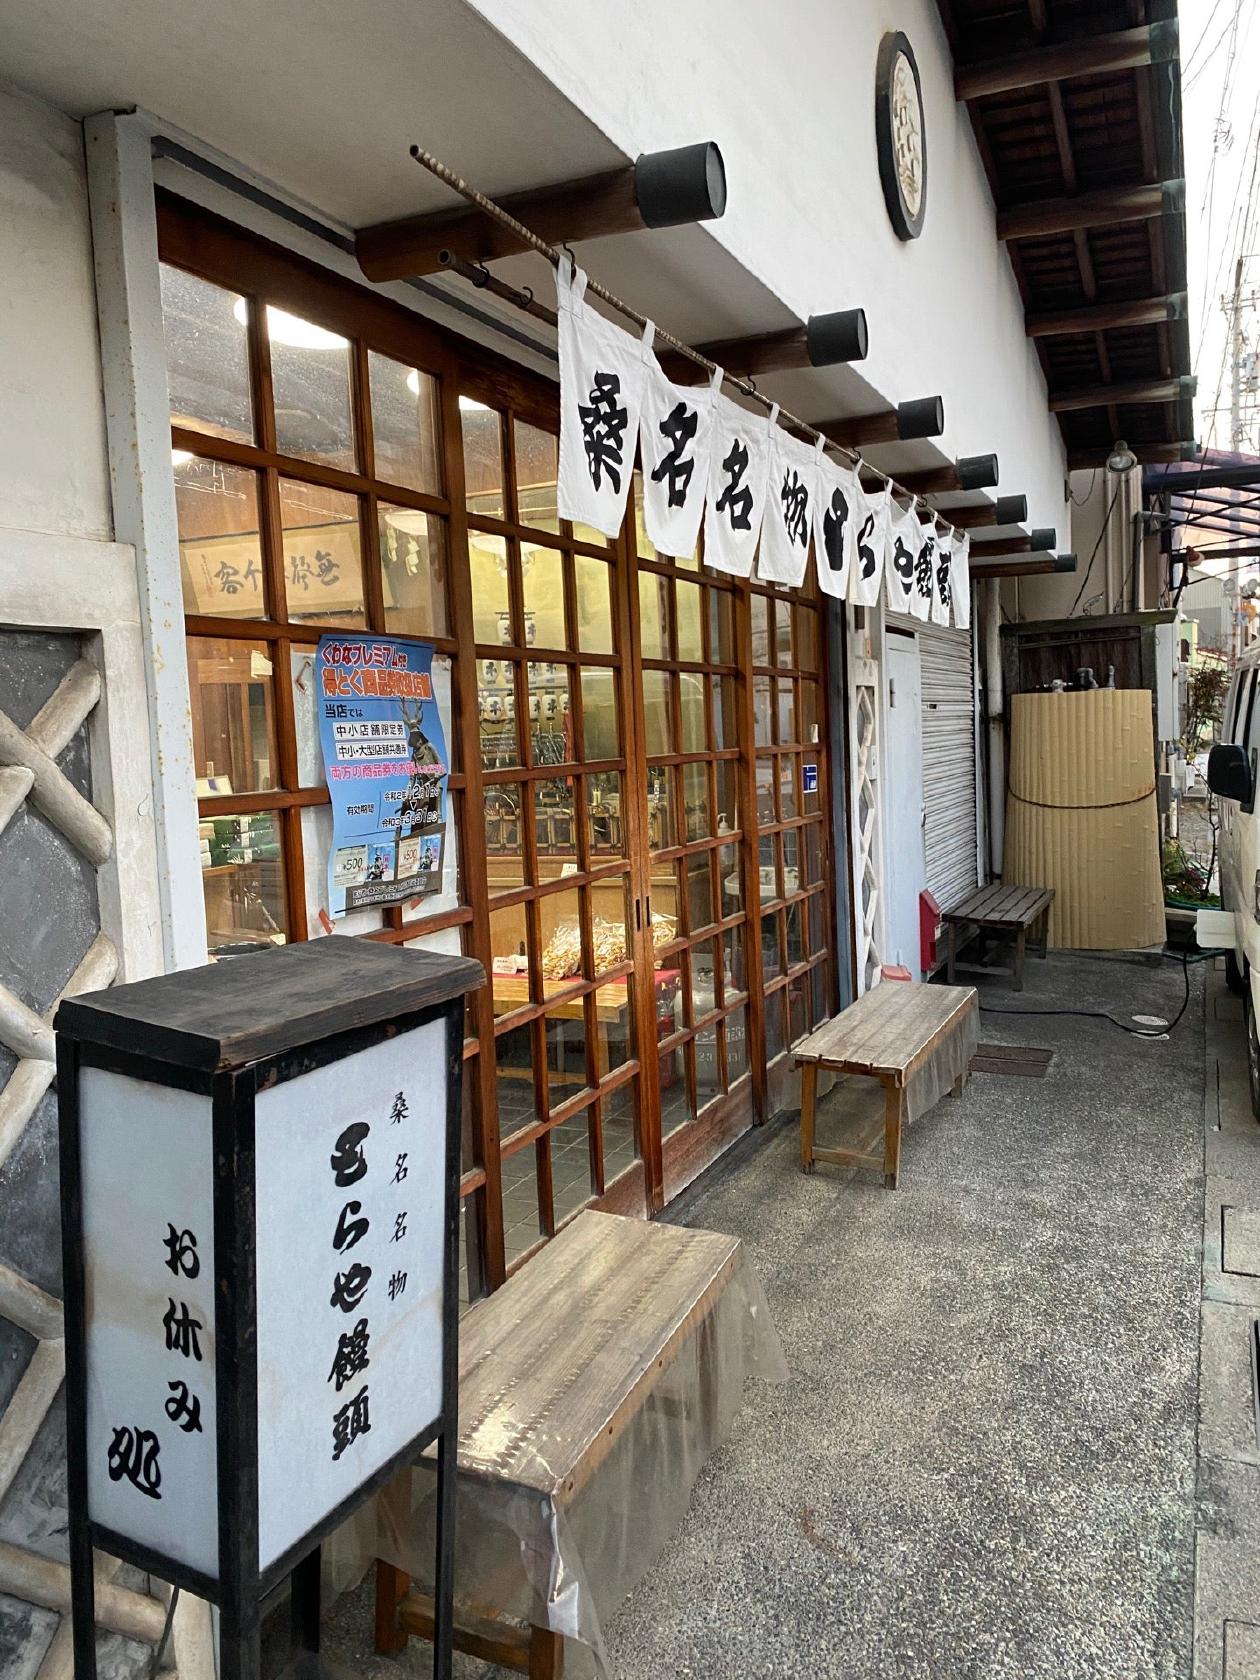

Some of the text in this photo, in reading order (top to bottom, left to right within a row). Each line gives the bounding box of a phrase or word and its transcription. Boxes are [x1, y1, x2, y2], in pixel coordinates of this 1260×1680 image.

[325, 704, 363, 718] 当店では
[336, 724, 404, 737] 中小店舗限定券
[346, 803, 375, 816] 有効期間
[388, 1091, 409, 1302] 桑名名物
[108, 1223, 203, 1500] お休み処
